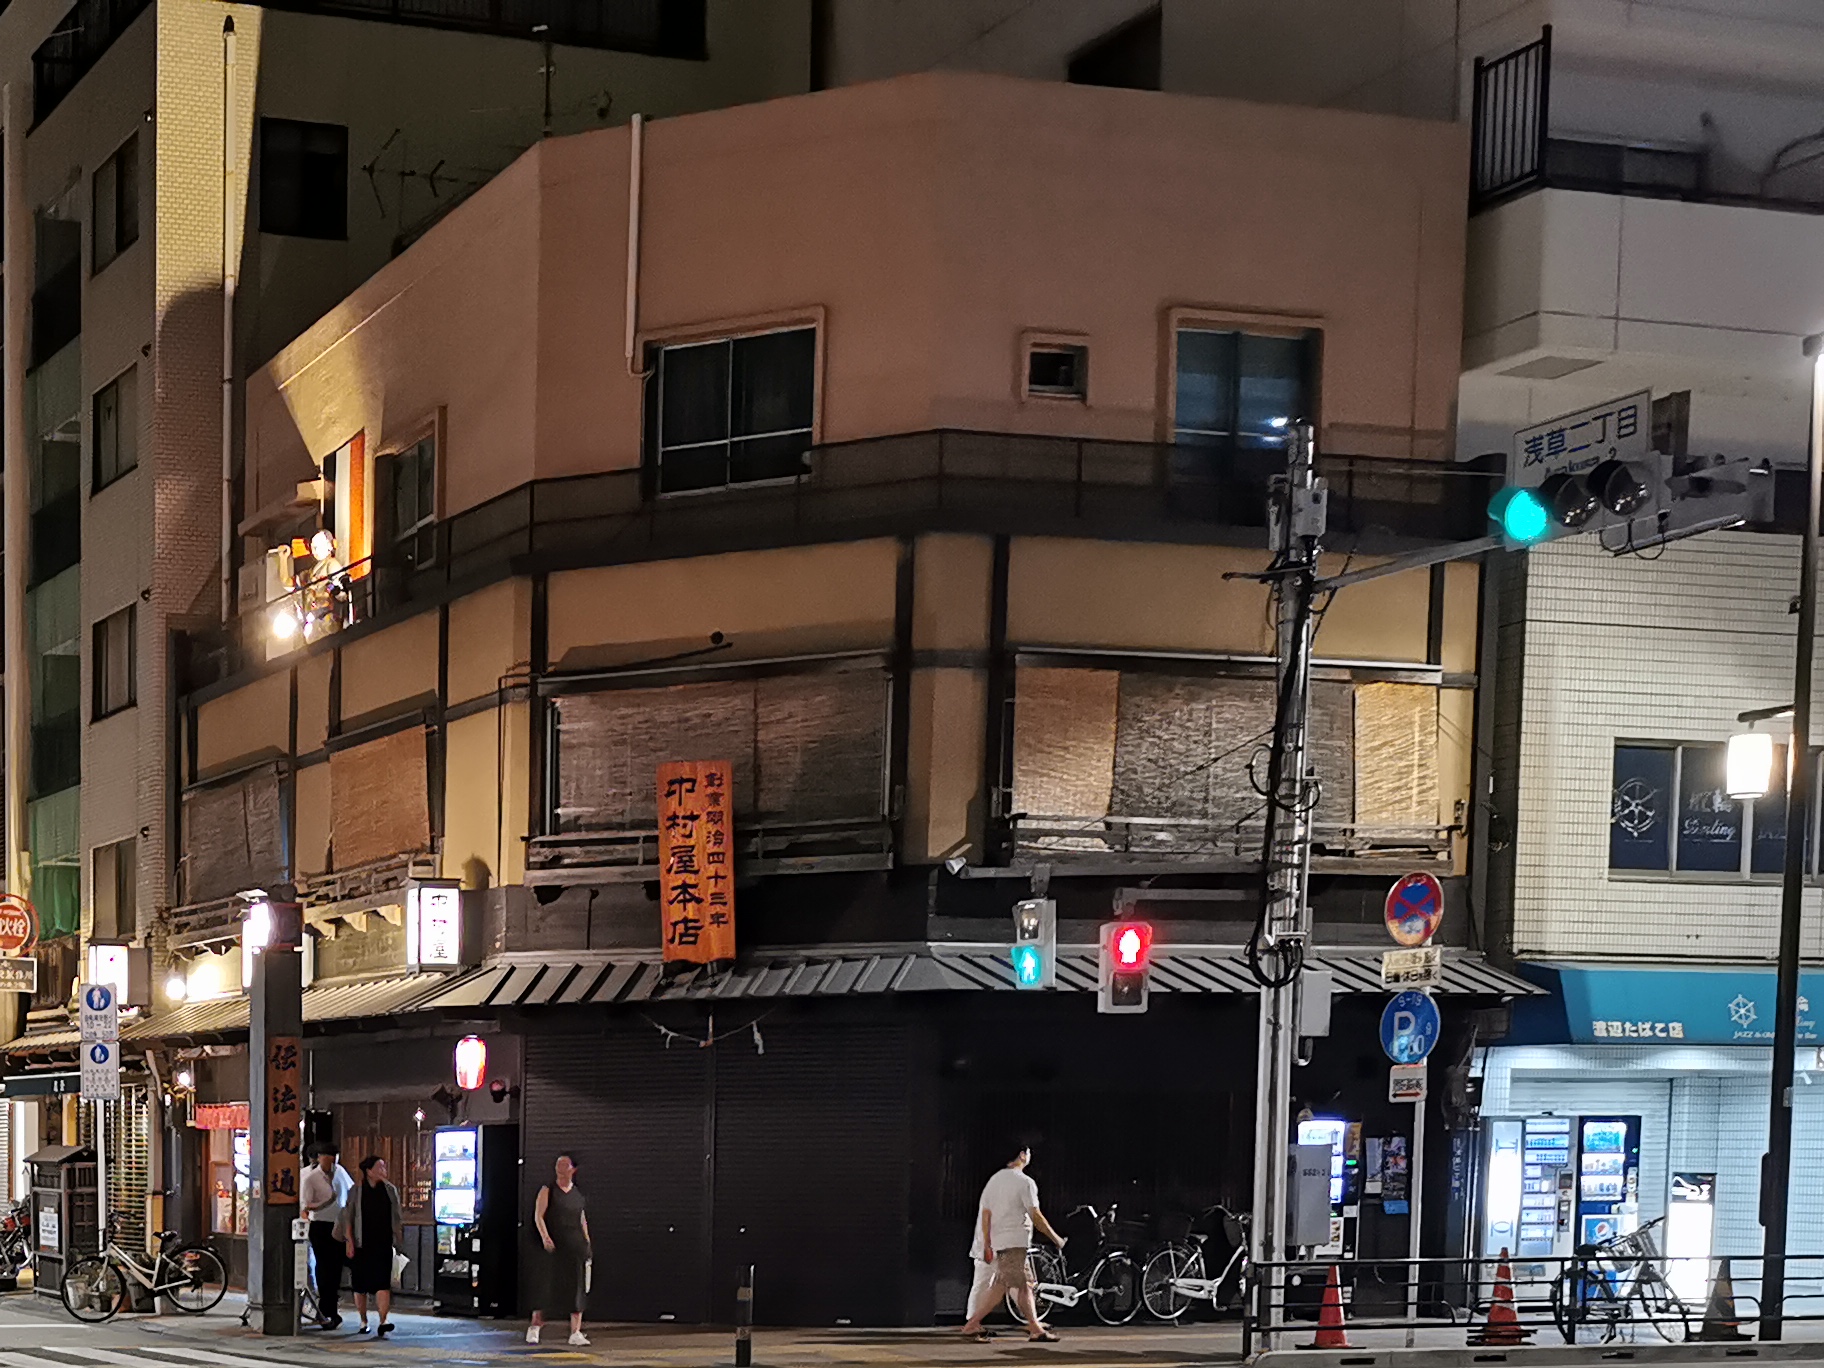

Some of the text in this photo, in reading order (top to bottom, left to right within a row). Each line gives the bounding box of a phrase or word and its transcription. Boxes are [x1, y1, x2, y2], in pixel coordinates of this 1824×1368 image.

[1524, 404, 1637, 468] 浅草二丁目
[664, 776, 705, 946] 中村屋本店
[1393, 1010, 1415, 1056] P
[1592, 1021, 1684, 1039] 渡辺たばこ店
[269, 1044, 298, 1197] 伝法院通
